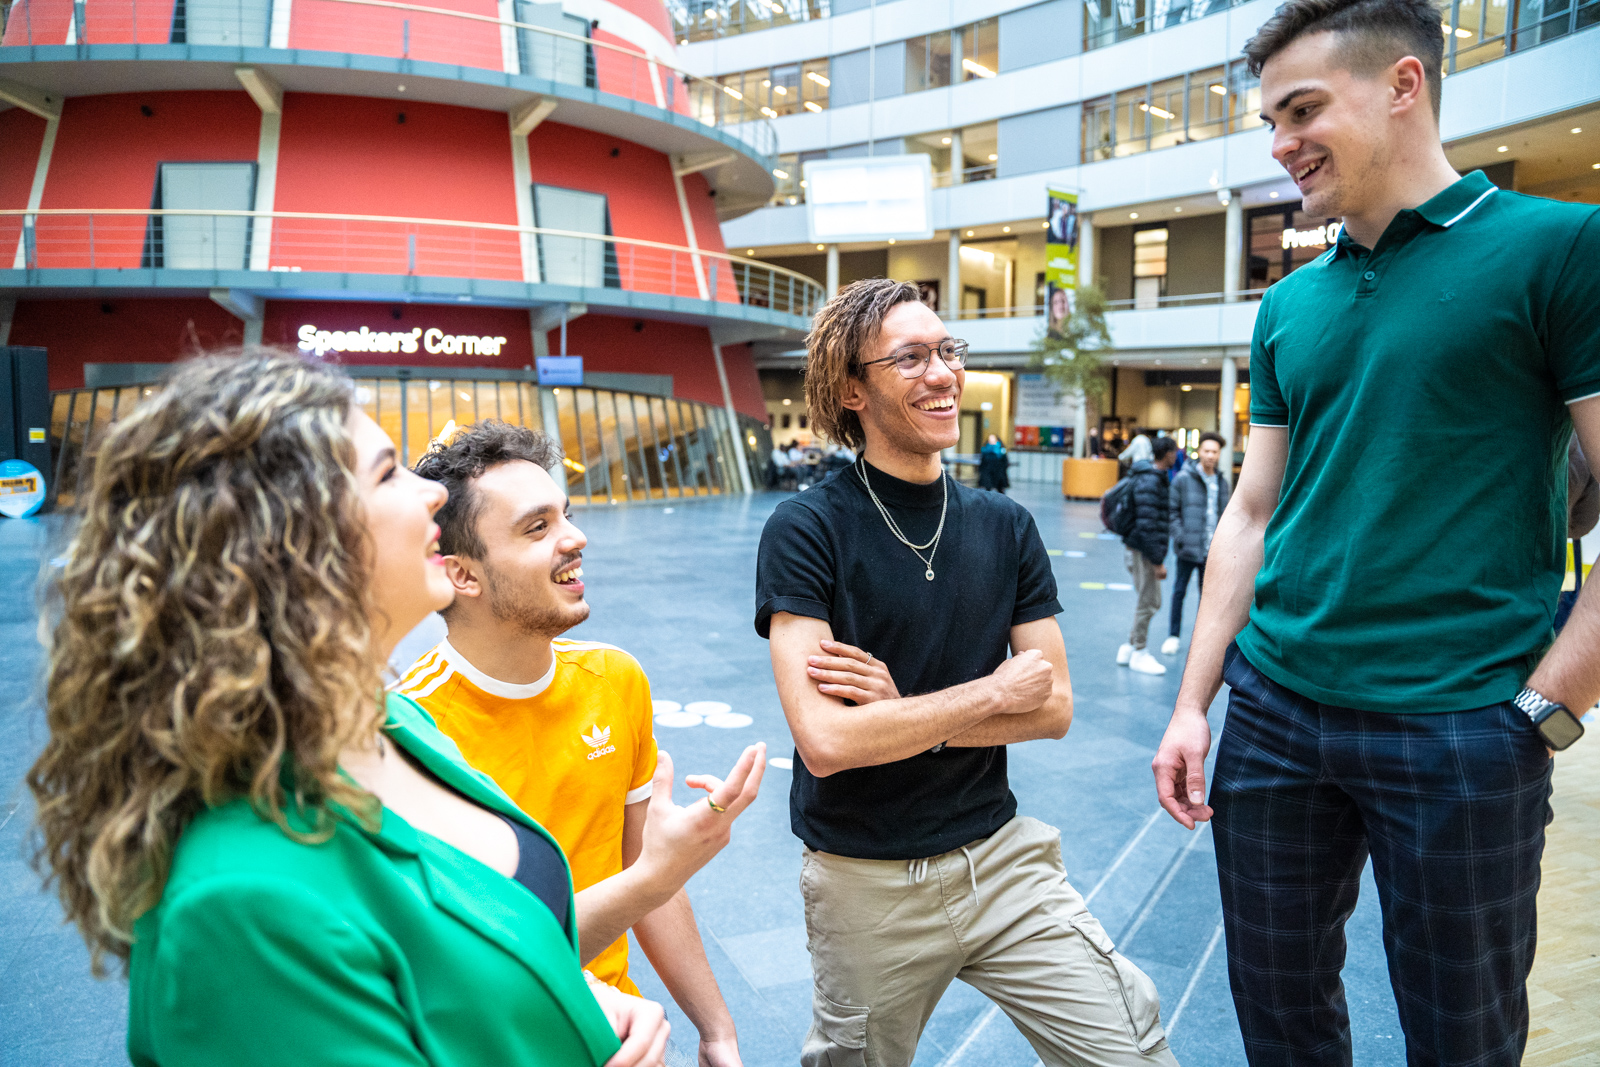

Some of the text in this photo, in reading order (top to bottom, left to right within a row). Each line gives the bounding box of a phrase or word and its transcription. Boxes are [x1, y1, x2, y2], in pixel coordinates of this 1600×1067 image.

[1282, 227, 1327, 249] Front
[298, 324, 507, 356] Speakers' Corner
[587, 745, 616, 760] adidas
